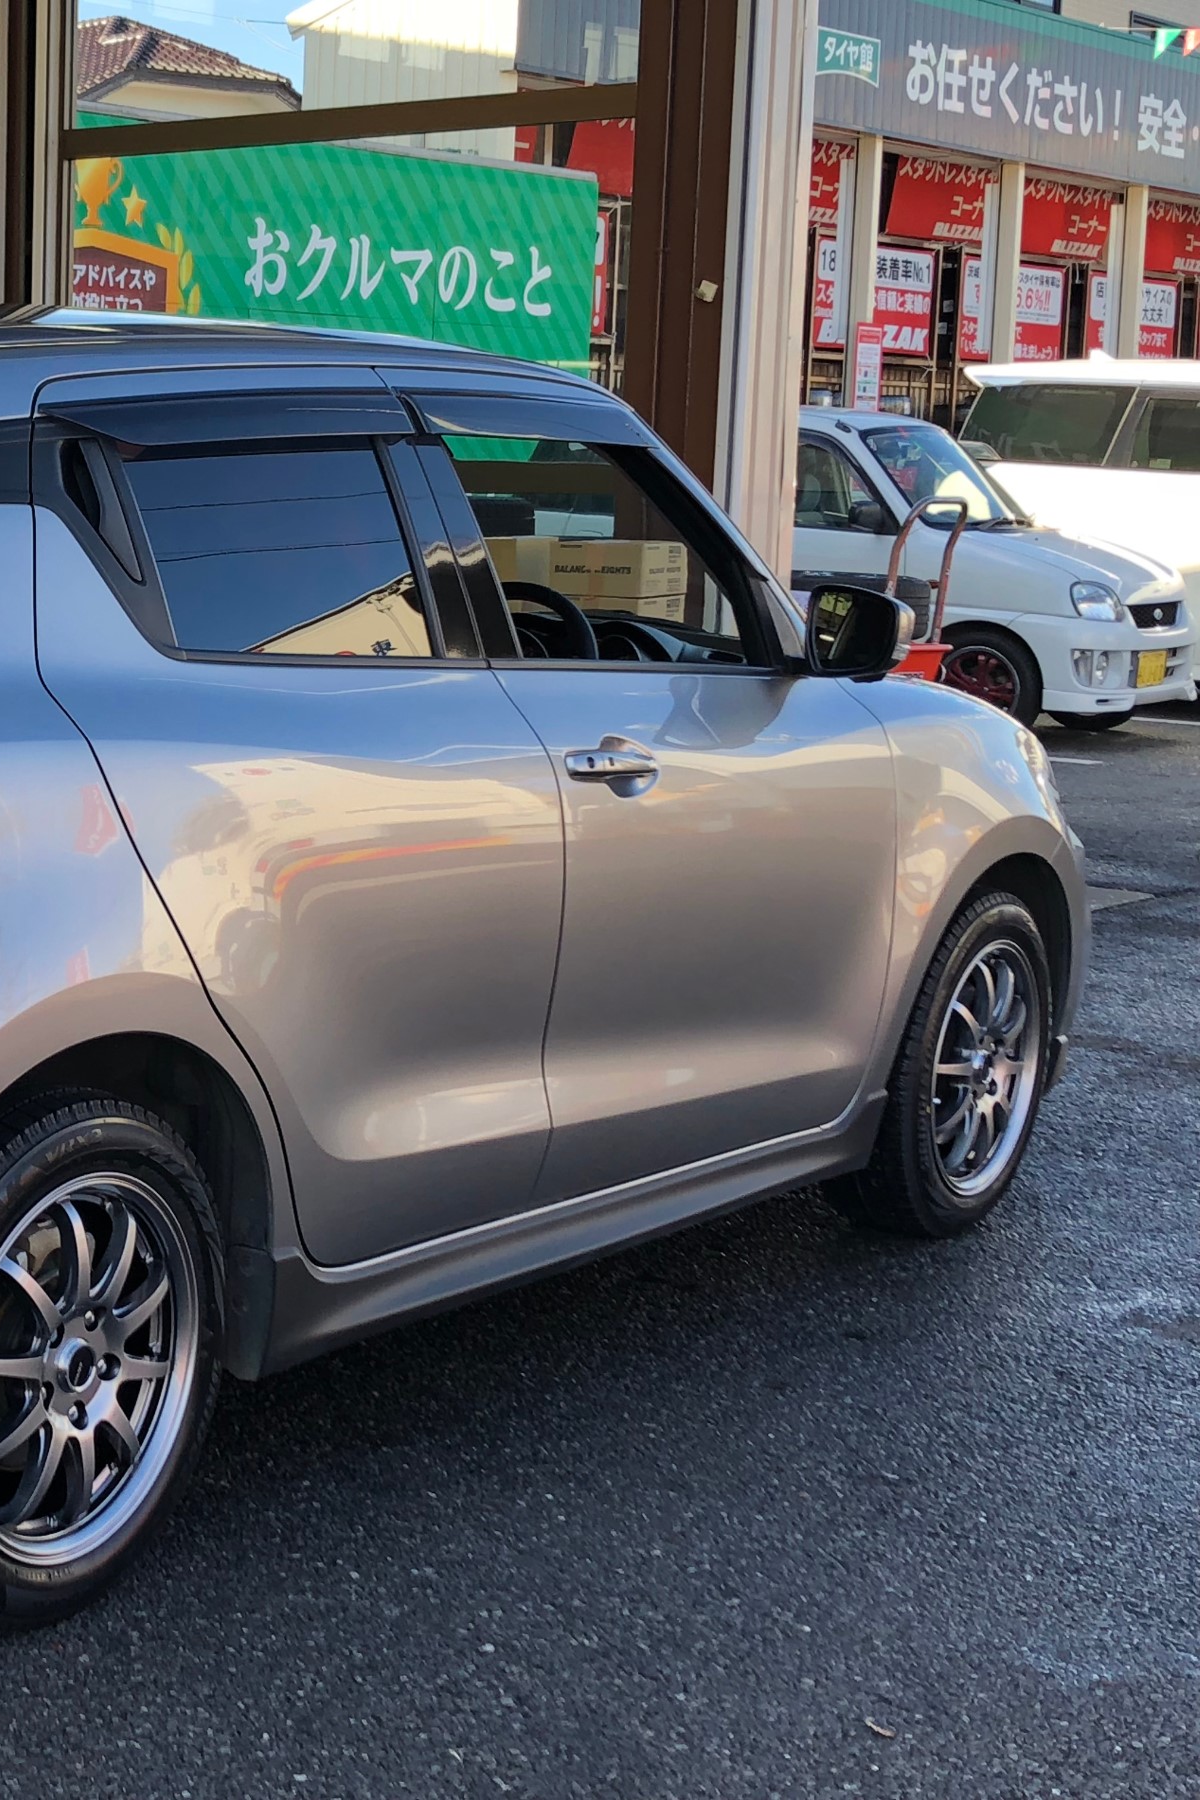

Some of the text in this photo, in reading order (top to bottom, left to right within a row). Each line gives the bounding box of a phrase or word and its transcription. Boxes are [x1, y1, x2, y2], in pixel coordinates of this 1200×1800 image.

[824, 36, 874, 74] タイヤ館
[905, 39, 1122, 142] お任せください！
[1067, 214, 1107, 239] コーナー
[245, 216, 552, 317] おクルマのこと
[1050, 238, 1102, 258] BLIZZAK
